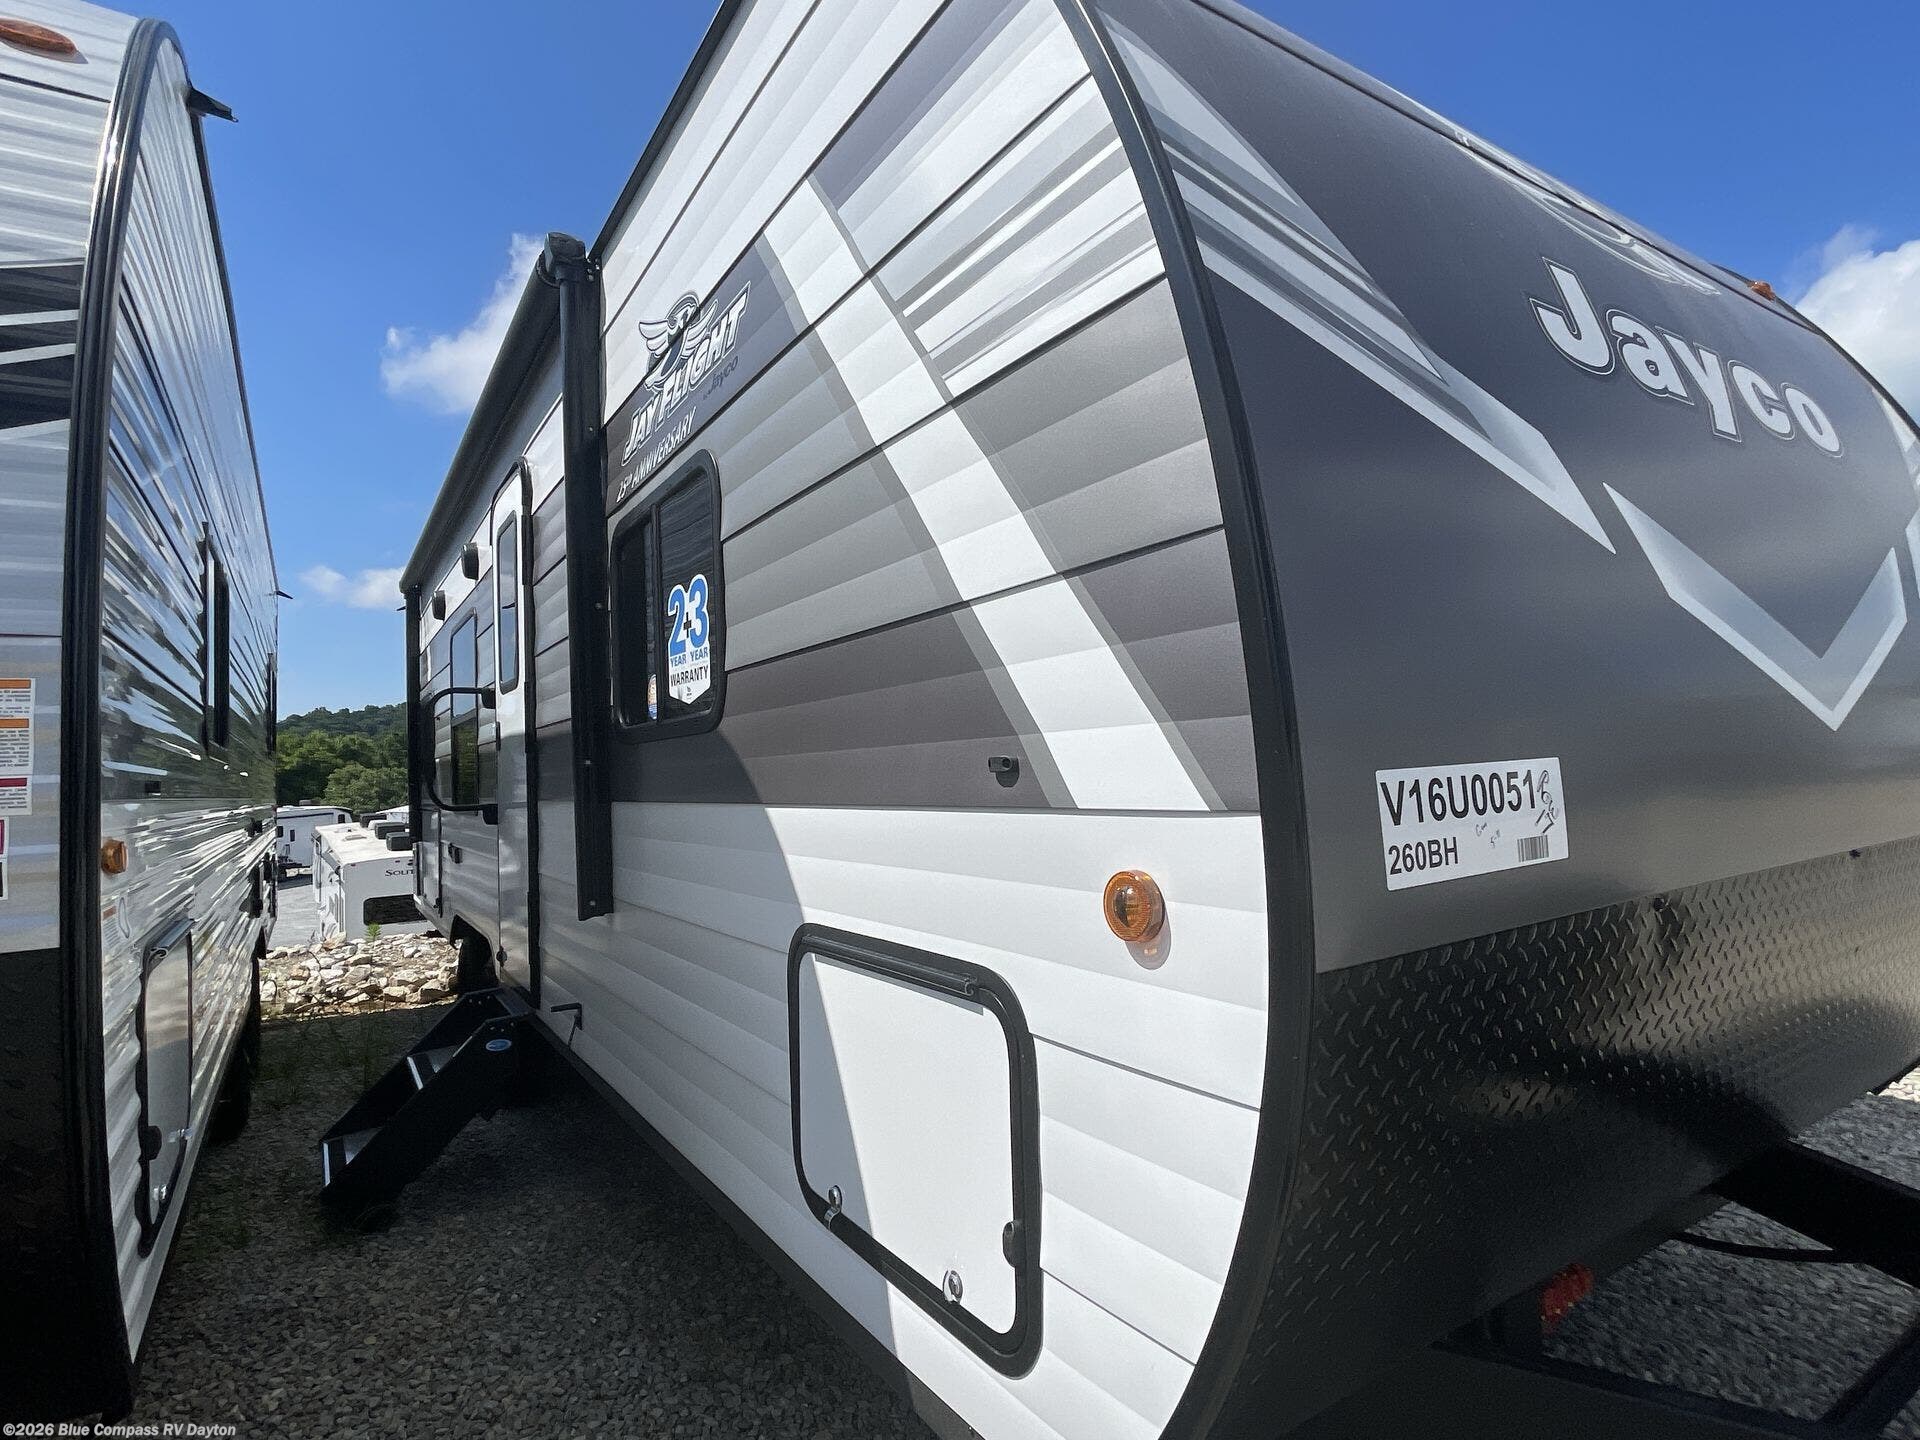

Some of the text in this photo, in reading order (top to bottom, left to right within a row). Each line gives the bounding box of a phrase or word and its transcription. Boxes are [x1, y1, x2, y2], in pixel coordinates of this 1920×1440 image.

[622, 281, 750, 466] JAY FLIGHT
[1530, 257, 1843, 457] Jayco
[631, 406, 697, 488] ANNIVERSARY
[670, 654, 687, 668] YEAR
[690, 646, 709, 662] YEAR
[670, 665, 709, 687] WARRANTY
[1388, 837, 1459, 875] 260BH
